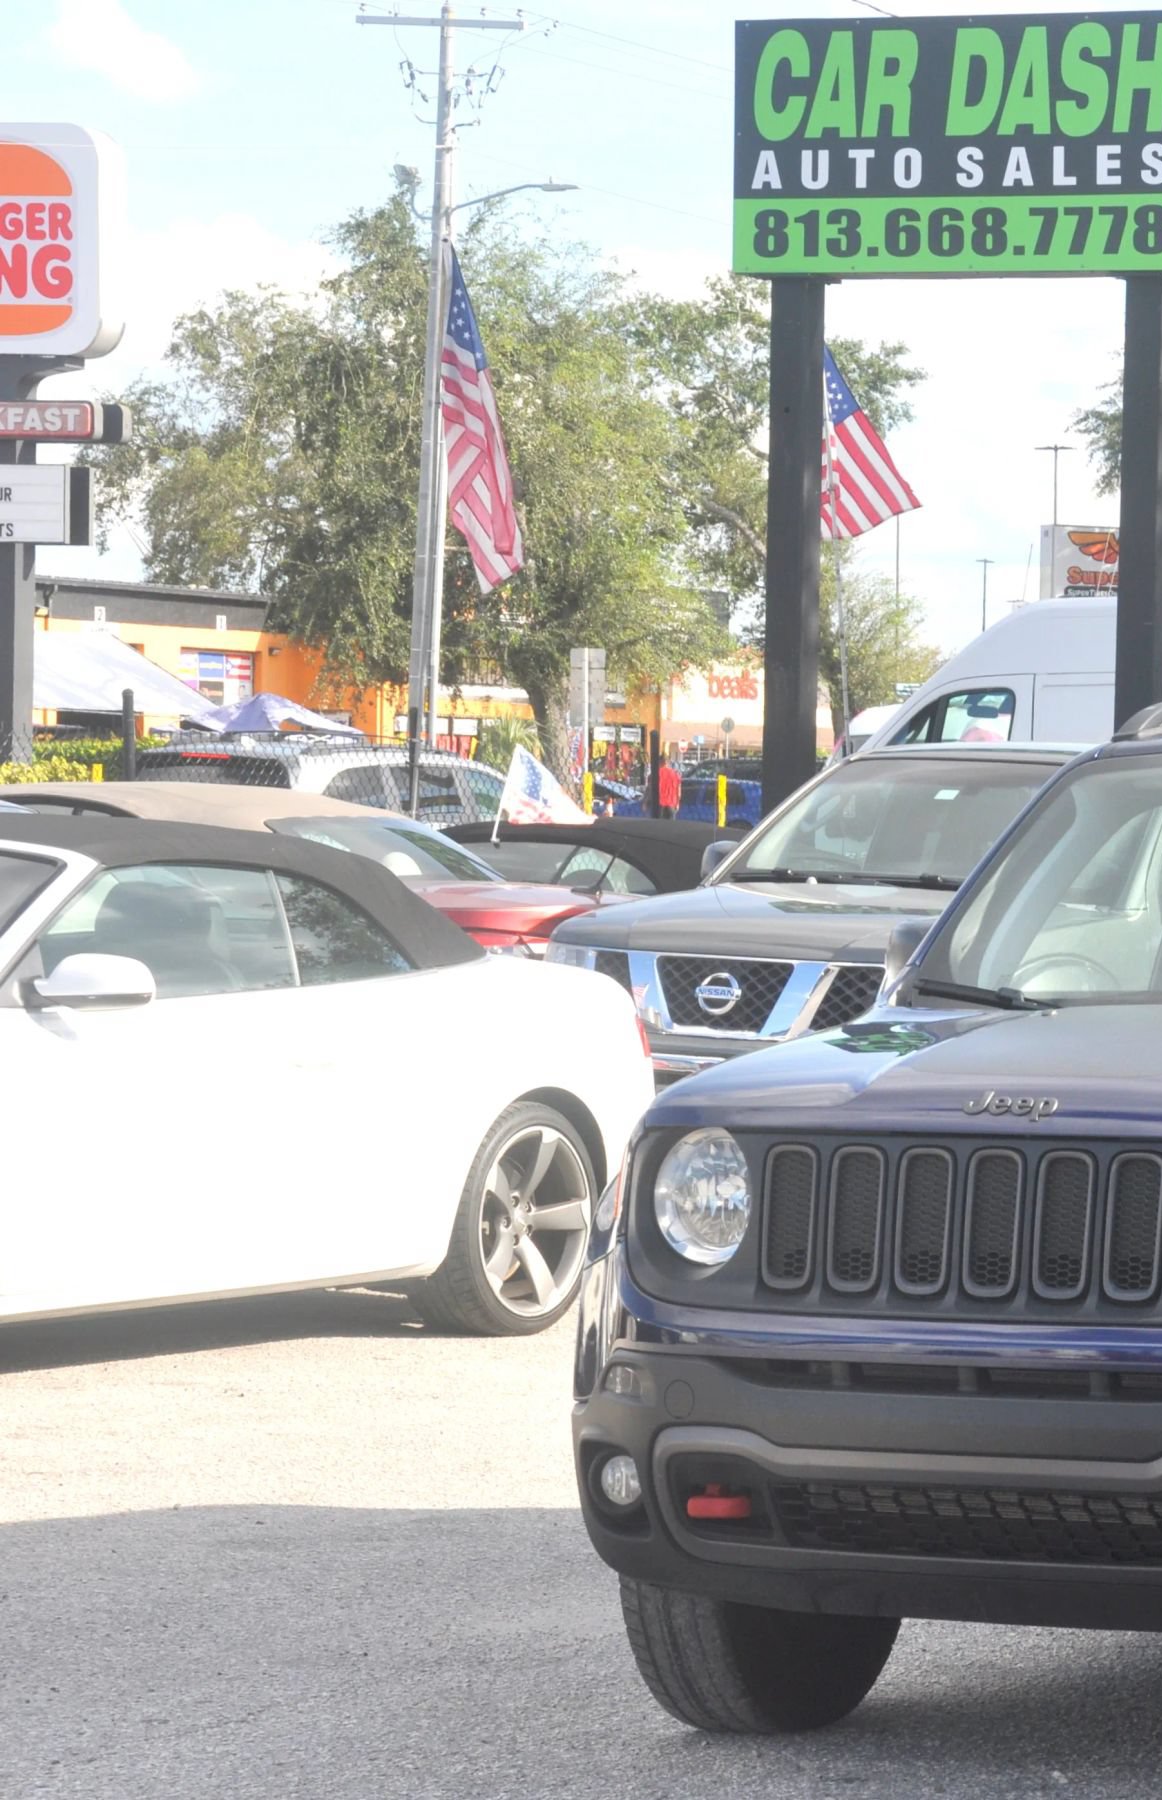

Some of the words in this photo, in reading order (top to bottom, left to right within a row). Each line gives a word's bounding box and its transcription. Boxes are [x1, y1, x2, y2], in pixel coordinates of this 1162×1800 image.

[753, 29, 919, 142] CAR
[751, 147, 923, 190] AUTO
[0, 202, 73, 241] GER
[698, 988, 735, 997] NISSAN
[963, 1090, 1059, 1122] Jeep
